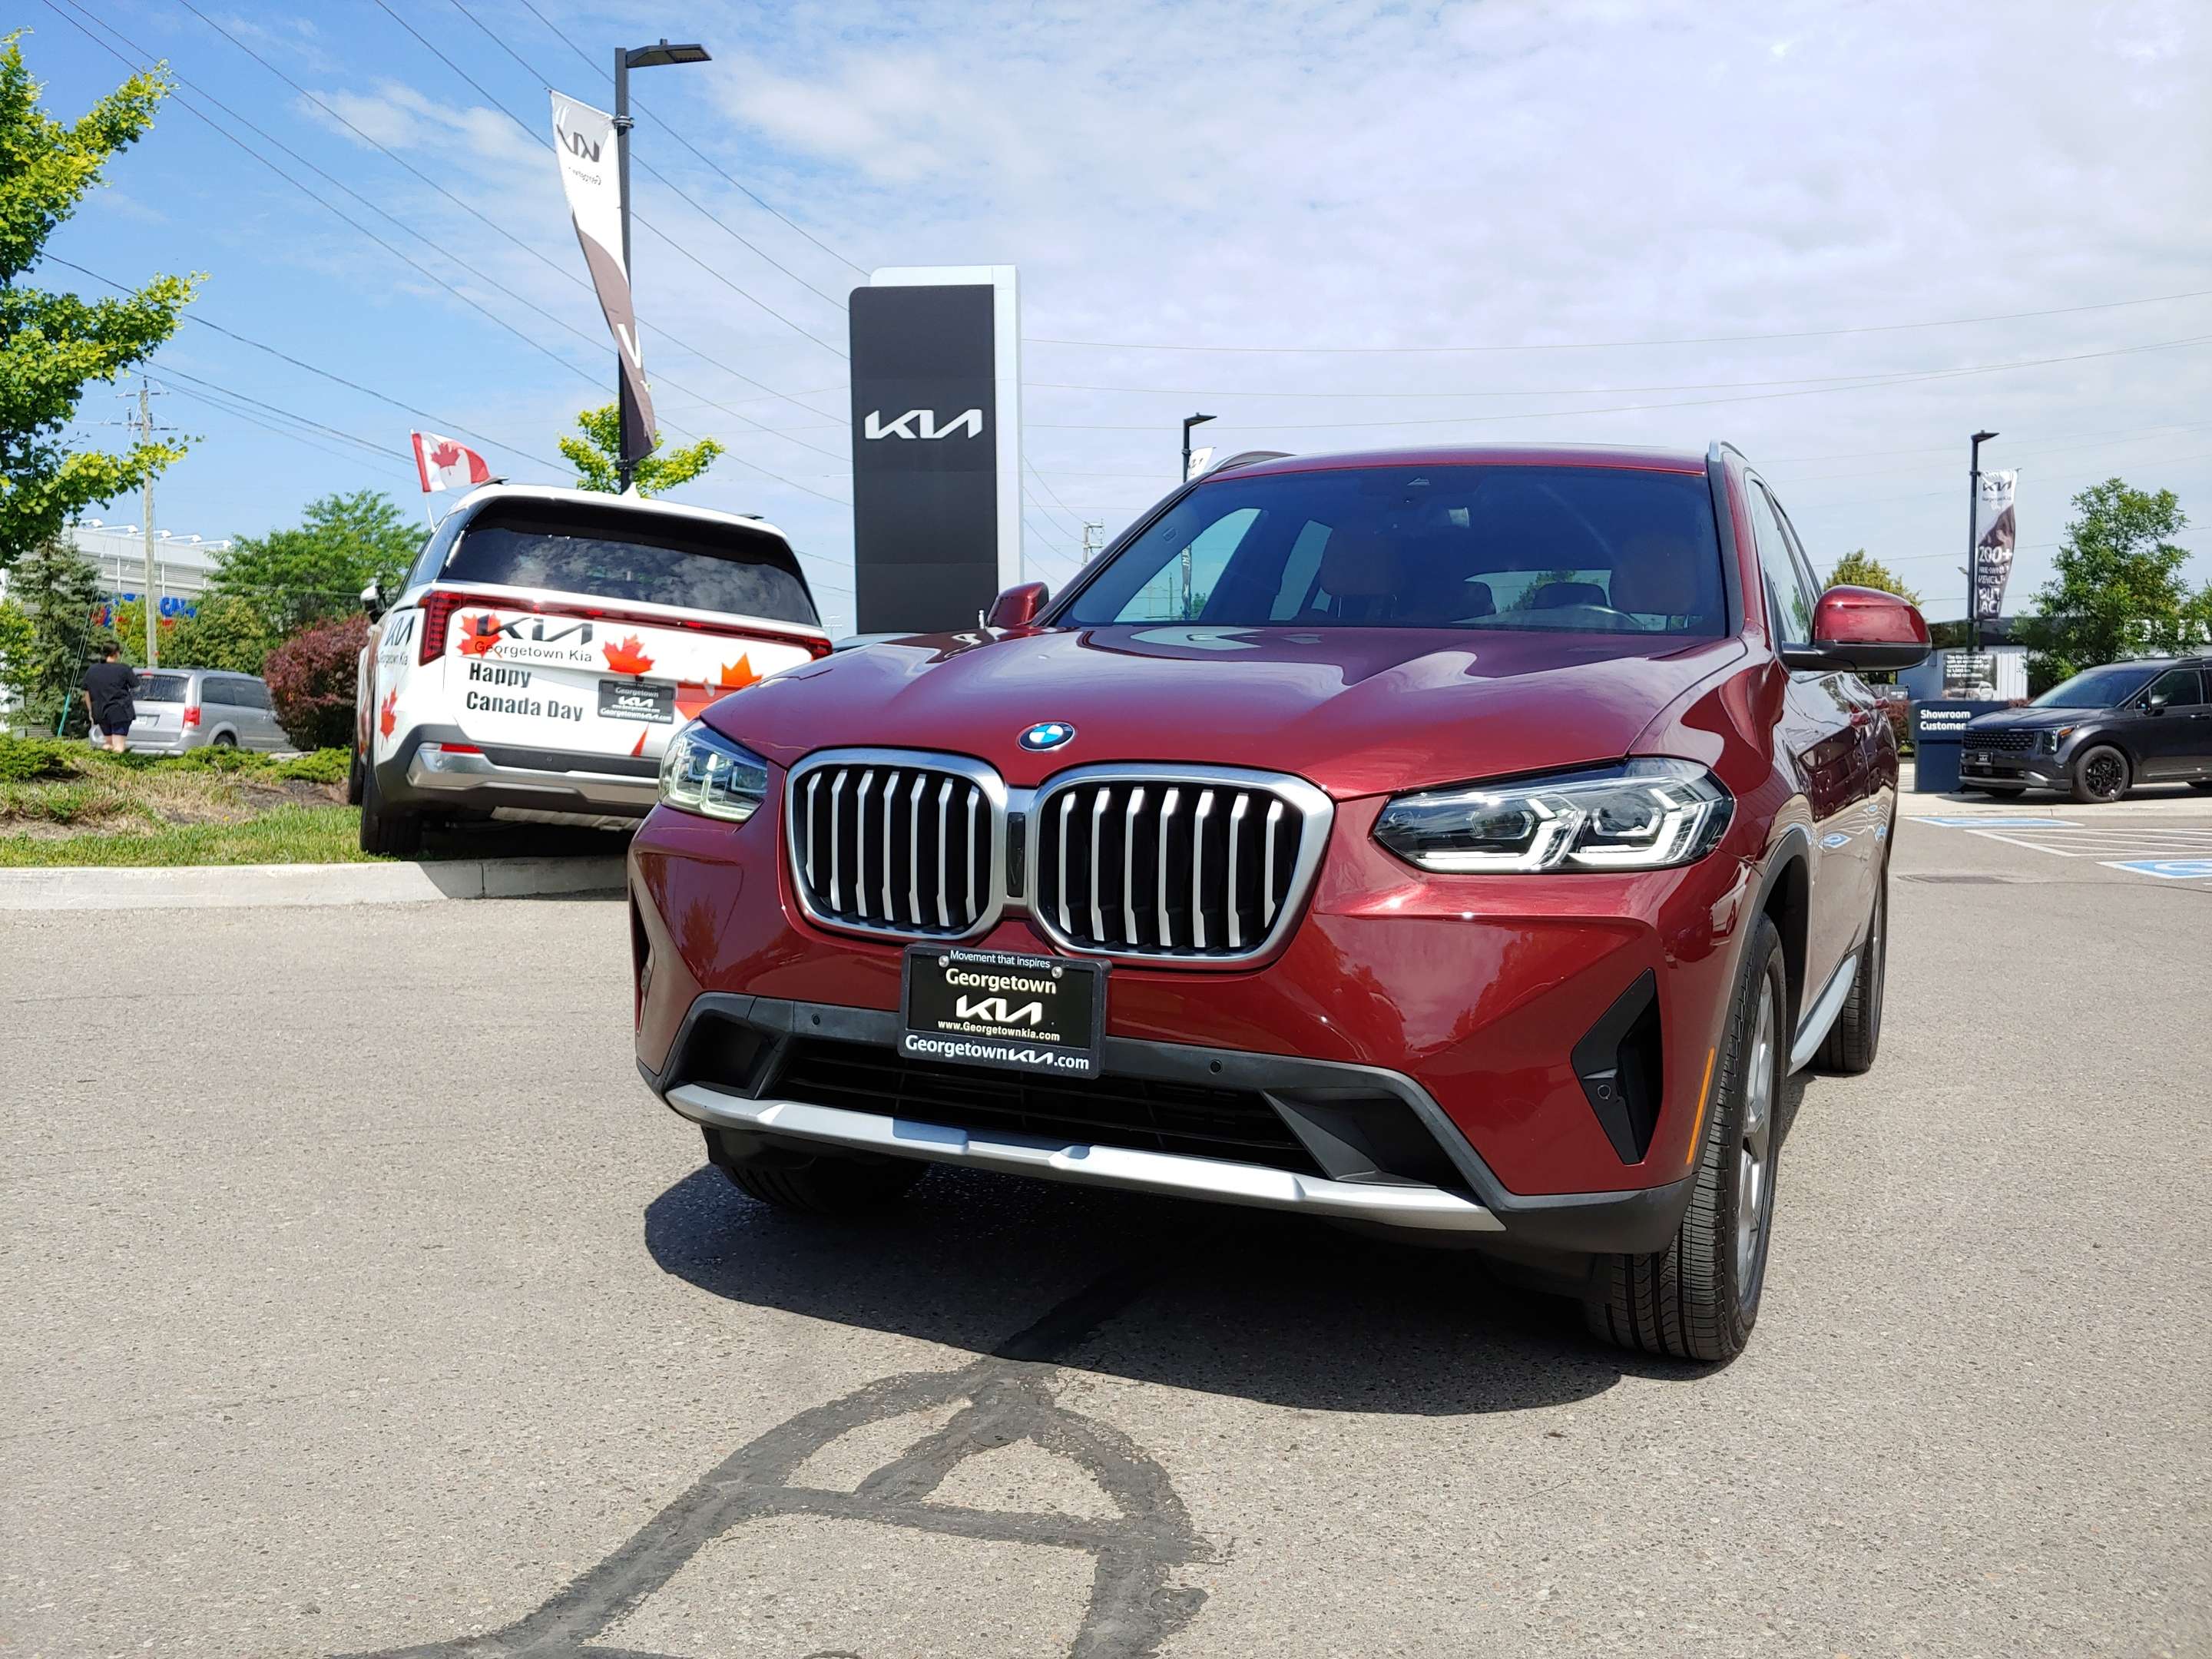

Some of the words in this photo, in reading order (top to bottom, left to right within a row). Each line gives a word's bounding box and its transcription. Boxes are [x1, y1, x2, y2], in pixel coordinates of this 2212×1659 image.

[864, 409, 983, 439] KIA
[1979, 546, 2012, 564] 200+
[1978, 574, 2005, 584] VEHICLE
[476, 614, 593, 646] KIA
[475, 641, 563, 661] Georgetown
[569, 649, 592, 662] Kia
[469, 662, 531, 688] Happy
[615, 687, 659, 698] Georgetown
[618, 696, 654, 708] KIA
[466, 690, 541, 716] Canada
[547, 700, 584, 722] Day
[1920, 709, 1971, 720] Showroom
[1920, 720, 1967, 730] Customer
[950, 949, 996, 964] Movement
[998, 955, 1015, 965] that
[1017, 955, 1051, 969] inspires
[945, 968, 1057, 995] Georgetown
[955, 994, 1043, 1026] KIA
[937, 1019, 1061, 1041] www.Georgetownkia.com
